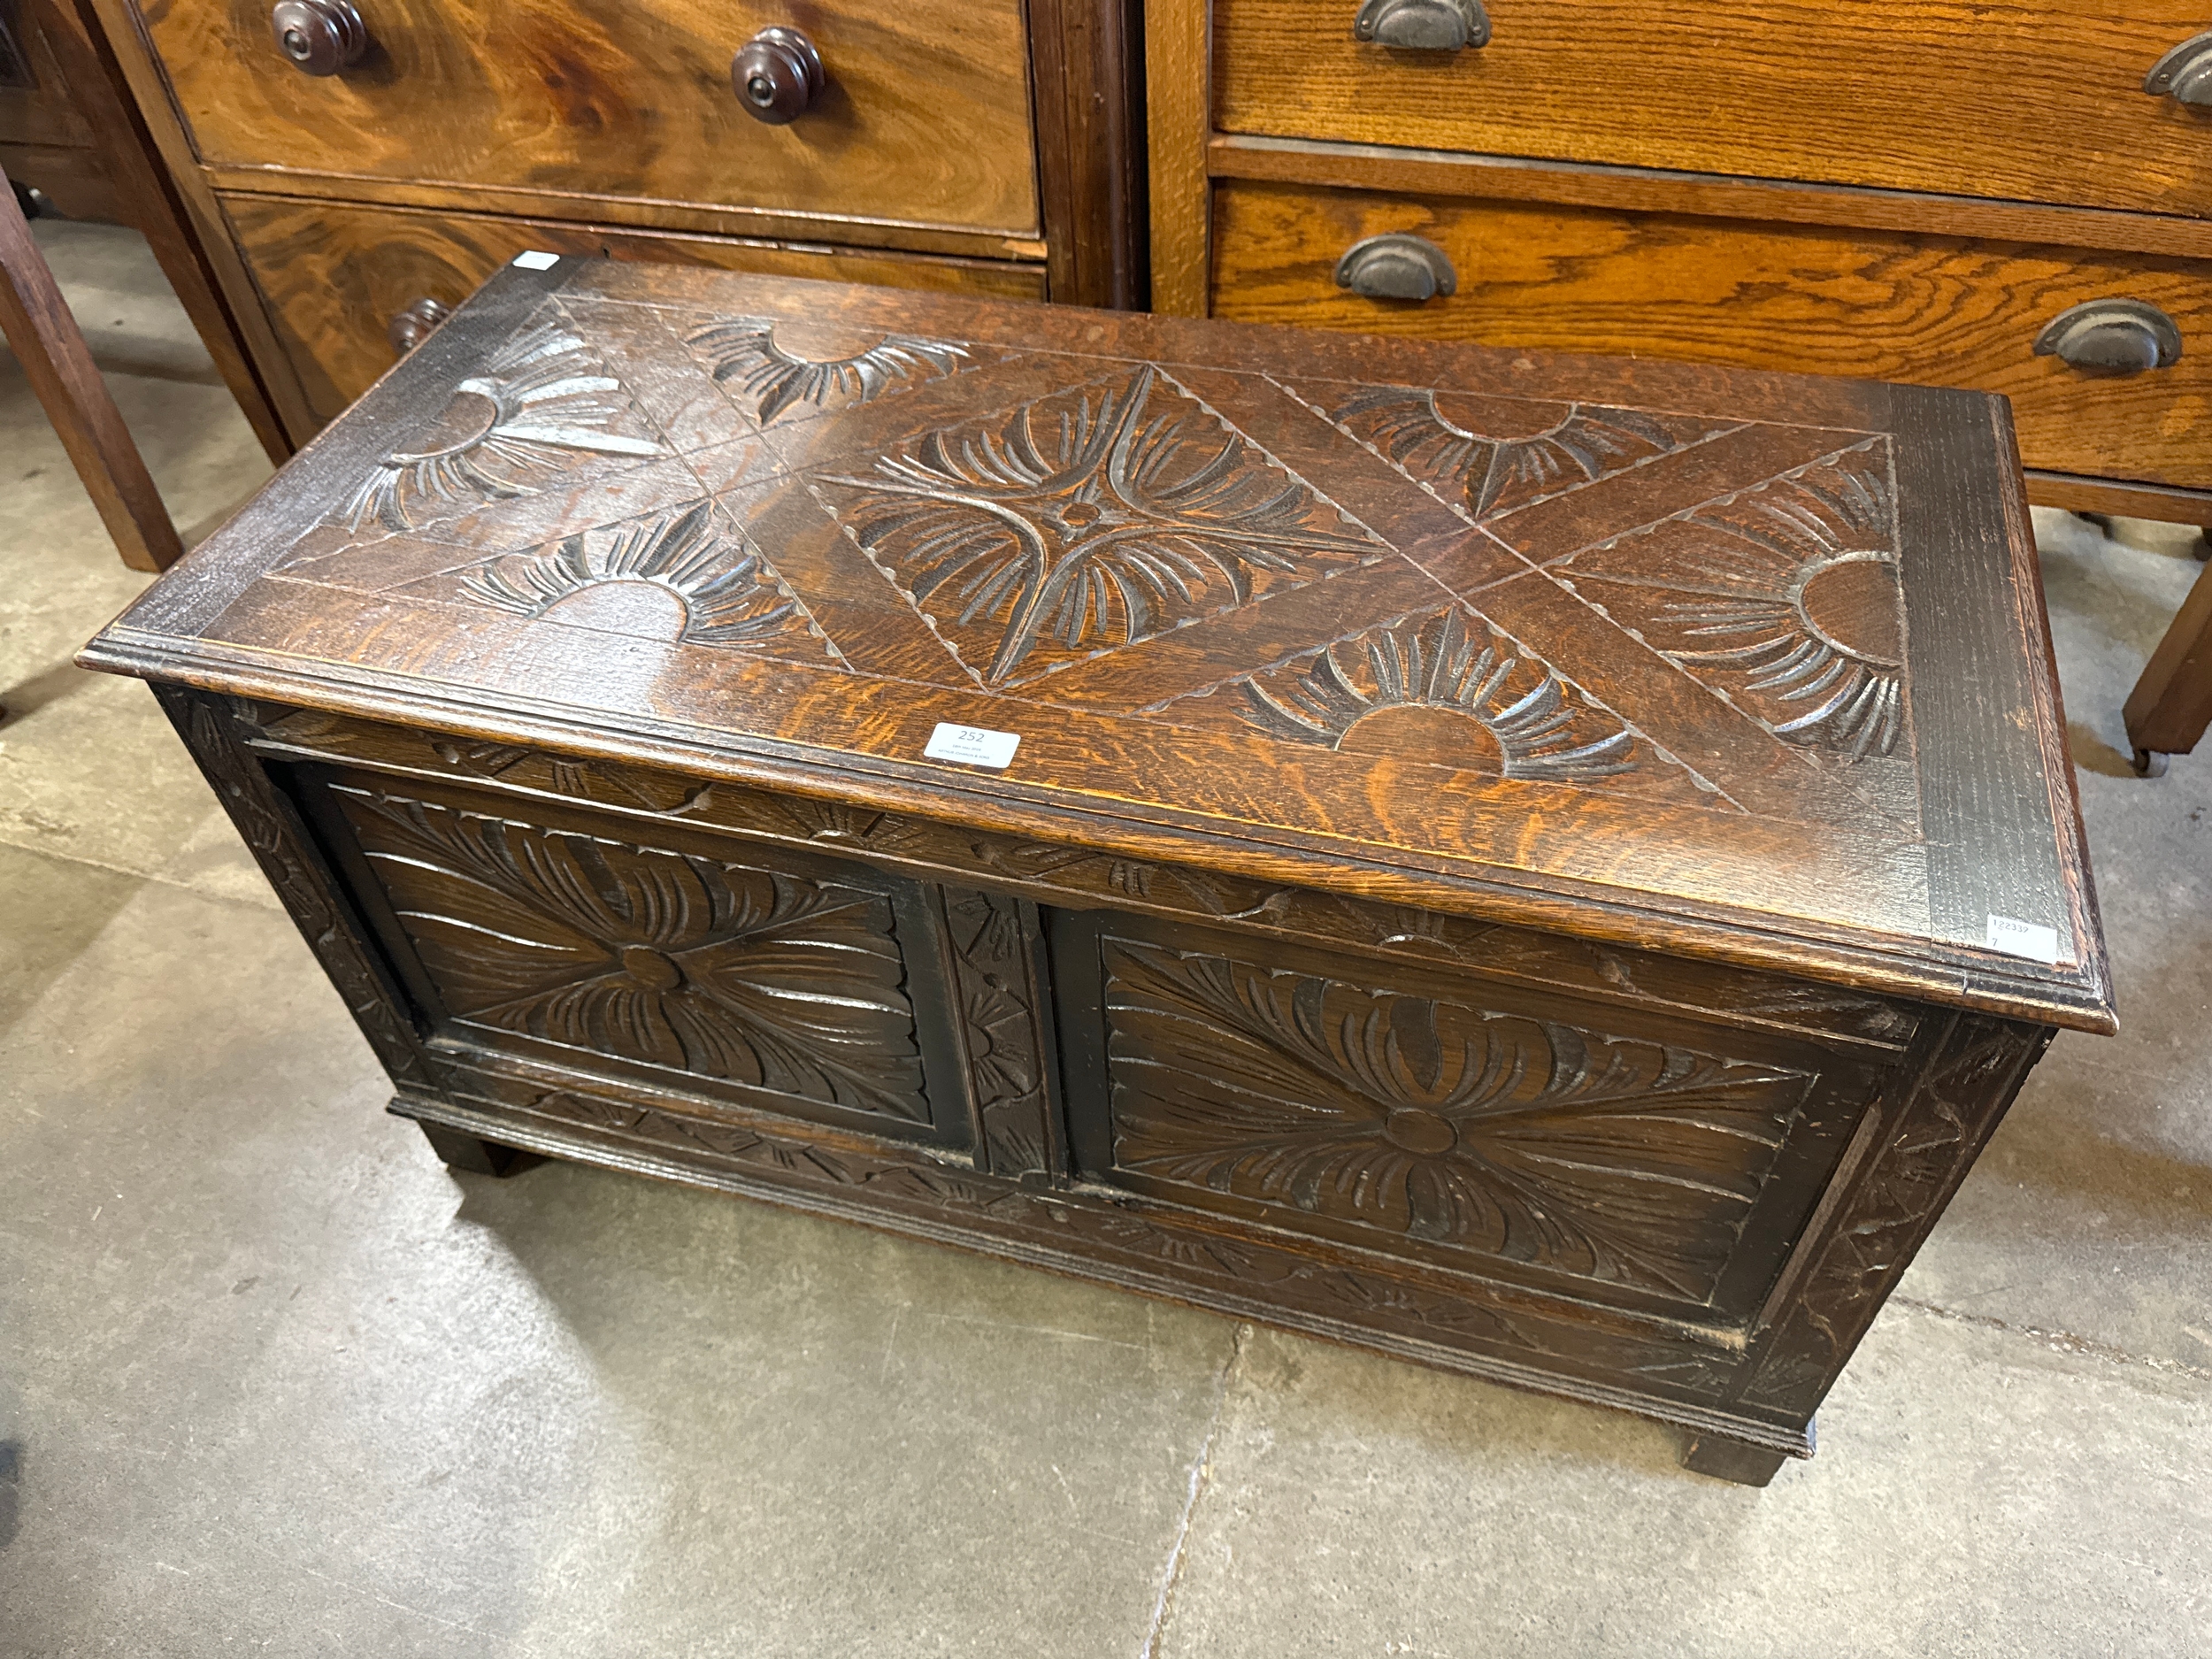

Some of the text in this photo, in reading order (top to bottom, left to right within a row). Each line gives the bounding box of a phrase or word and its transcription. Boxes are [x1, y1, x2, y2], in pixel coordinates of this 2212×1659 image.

[958, 730, 985, 742] 252
[1993, 919, 2029, 933] 122339
[1992, 937, 1998, 947] 7
